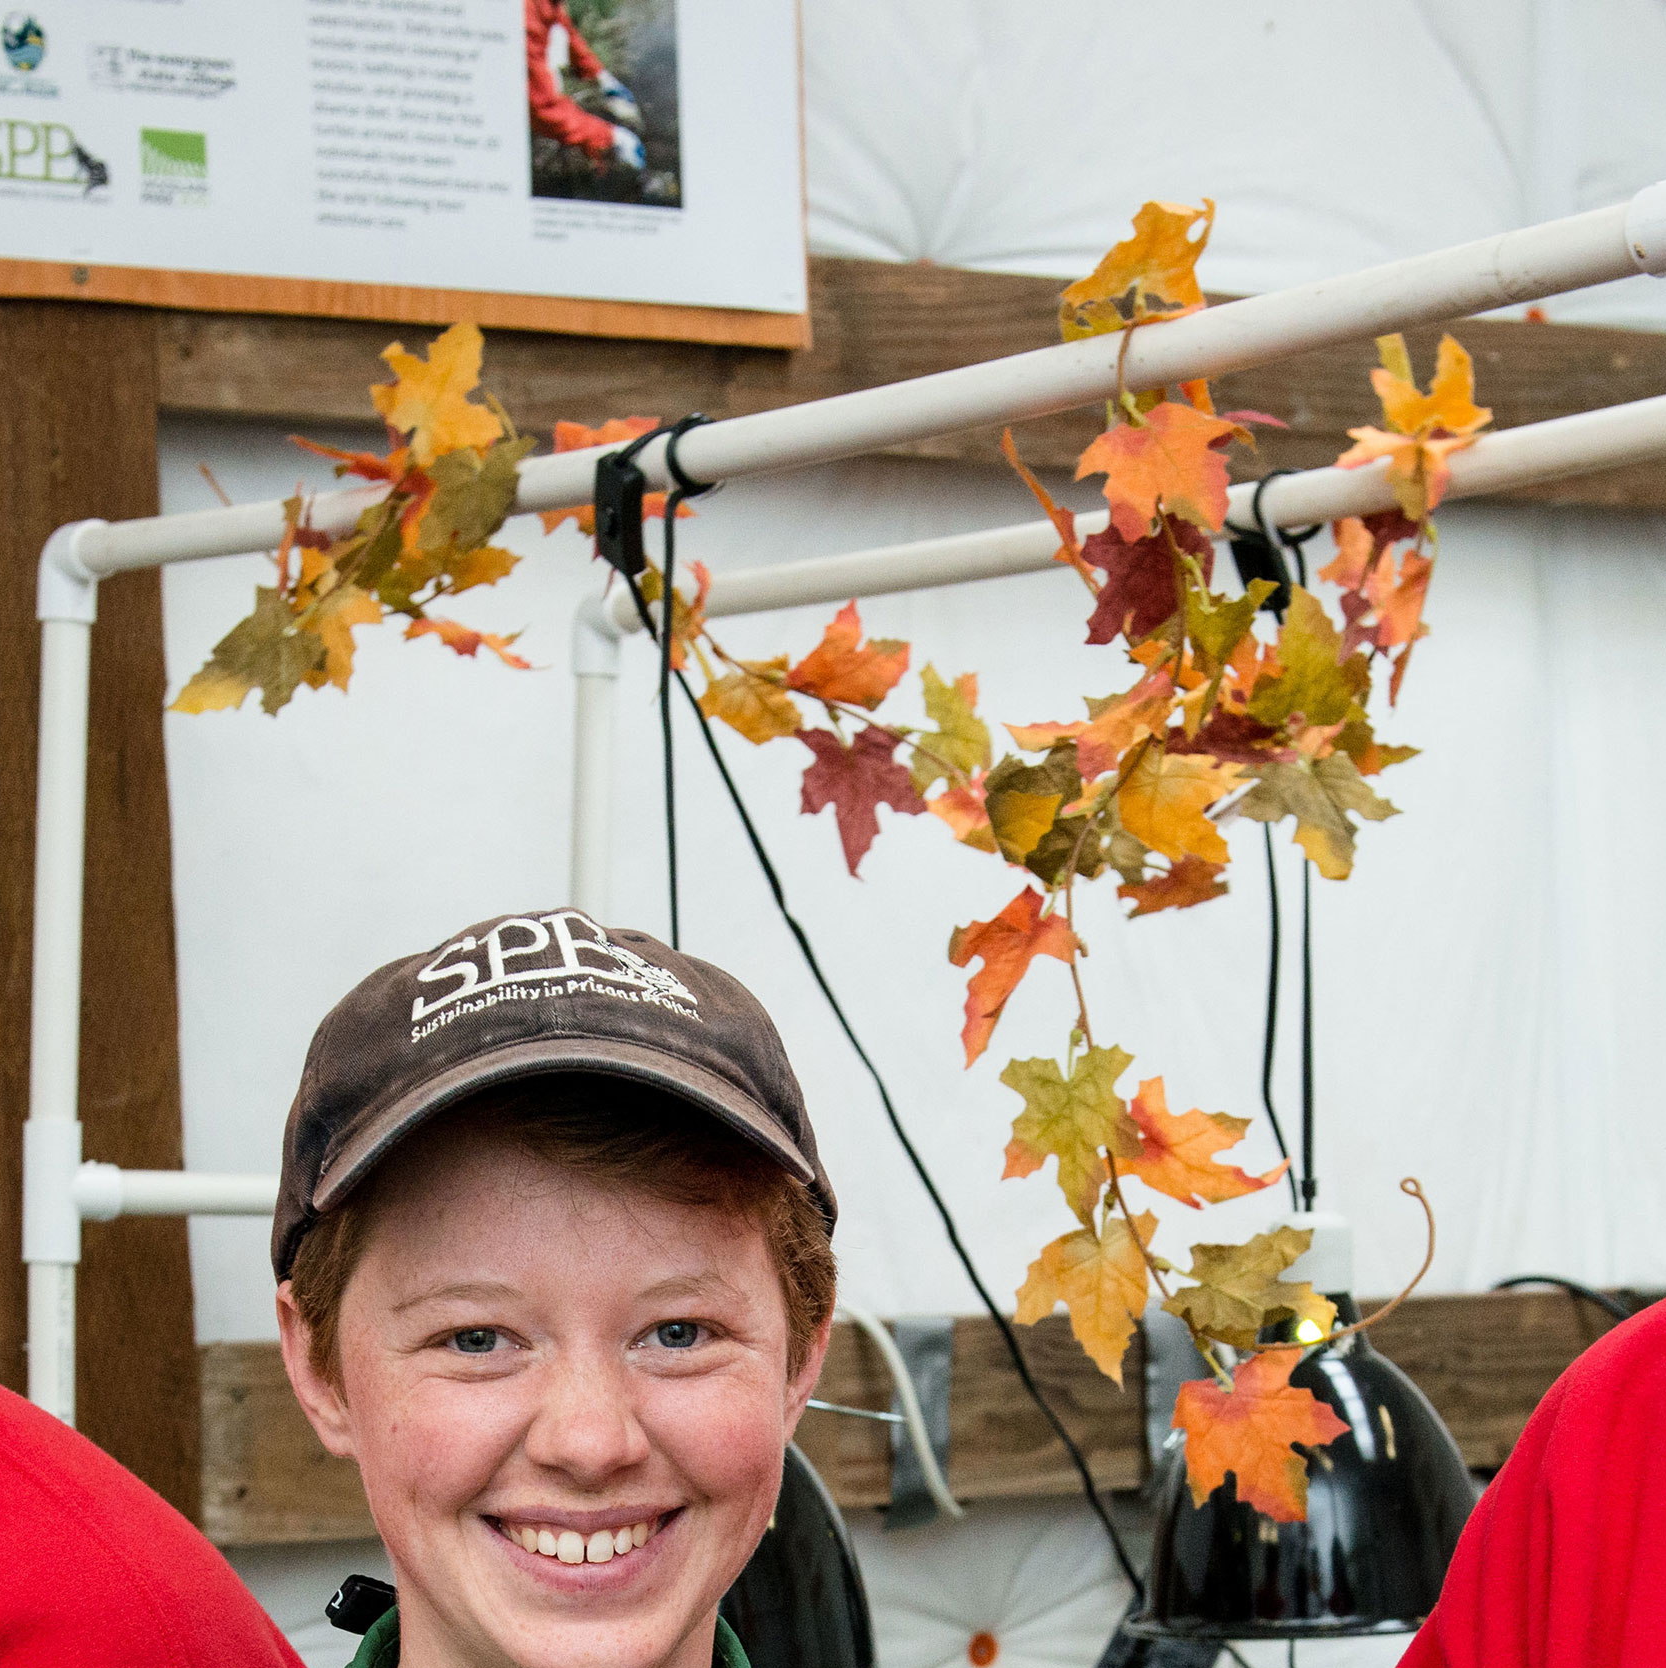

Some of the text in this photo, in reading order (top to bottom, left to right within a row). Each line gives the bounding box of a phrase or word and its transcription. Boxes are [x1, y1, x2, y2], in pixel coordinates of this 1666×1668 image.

[410, 982, 540, 1043] Sustainability
[543, 983, 565, 998] in
[567, 976, 640, 1004] Prisons
[411, 911, 608, 1021] SPP
